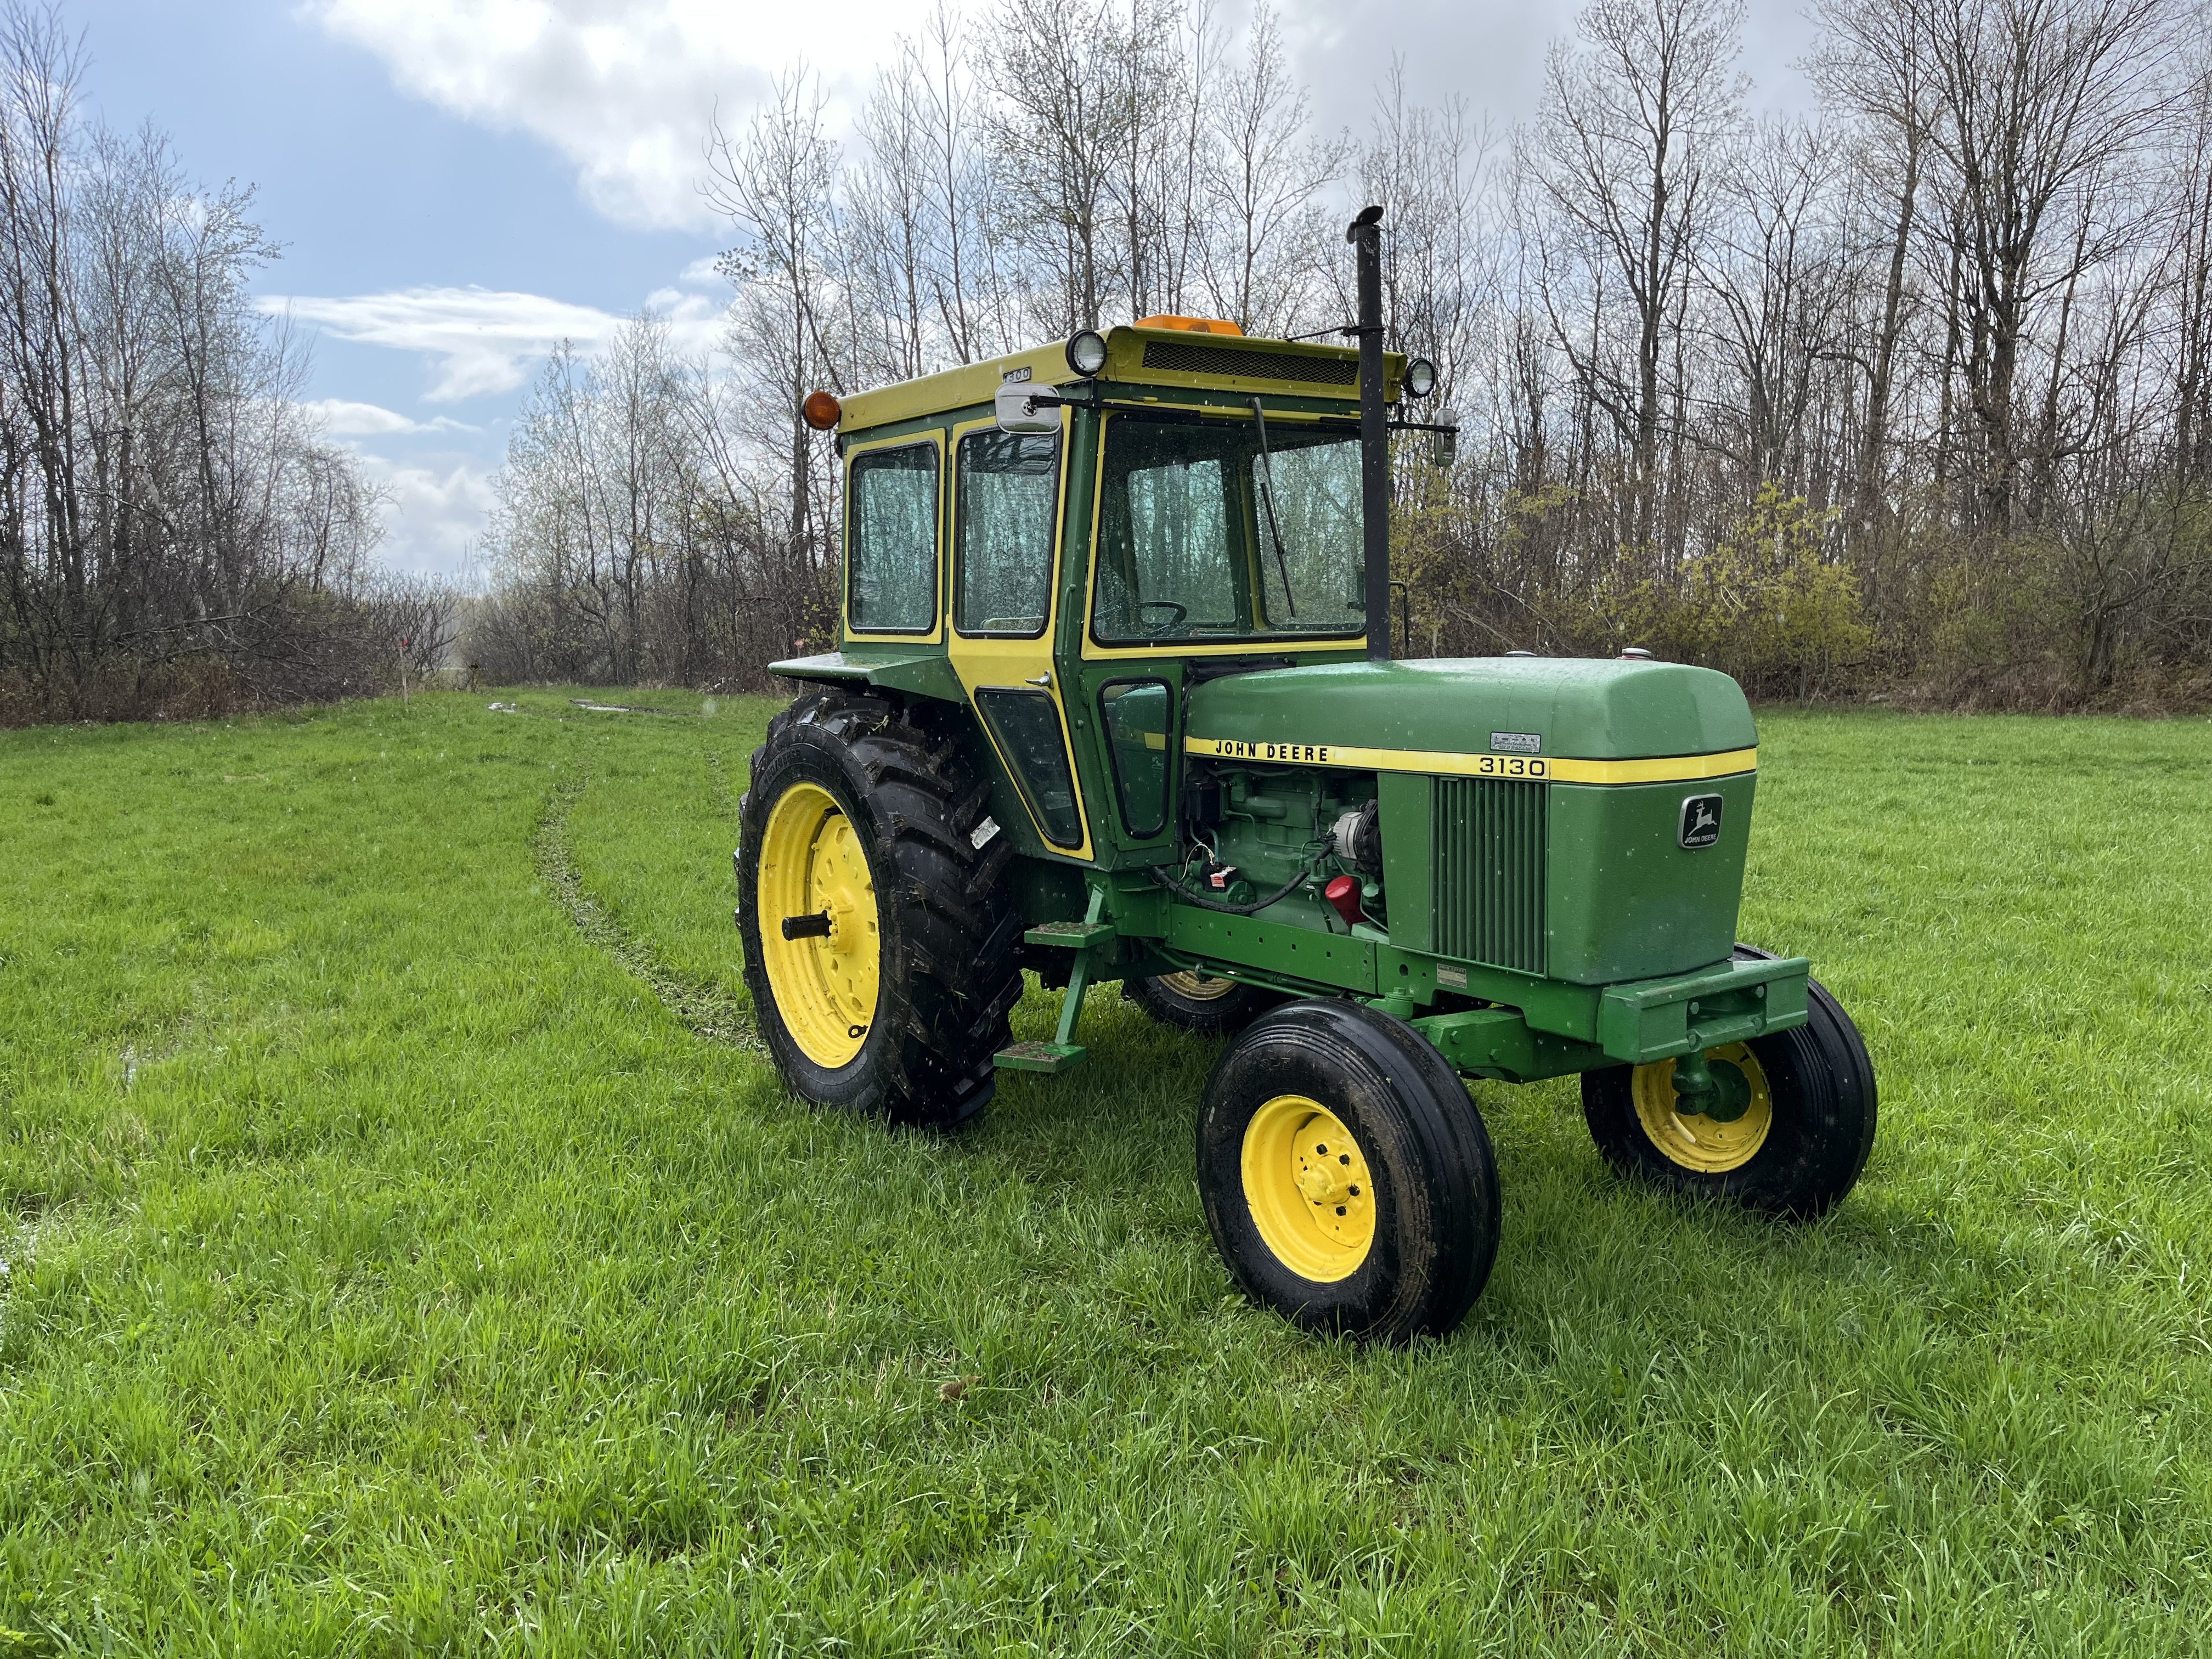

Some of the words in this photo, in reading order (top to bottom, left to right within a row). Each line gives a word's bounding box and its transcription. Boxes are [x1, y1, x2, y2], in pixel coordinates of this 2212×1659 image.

[1216, 741, 1256, 757] JOHN
[1267, 745, 1327, 761] DEERE
[1480, 757, 1545, 776] 3130
[1684, 836, 1701, 844] JOHN
[1701, 833, 1717, 842] DEERE
